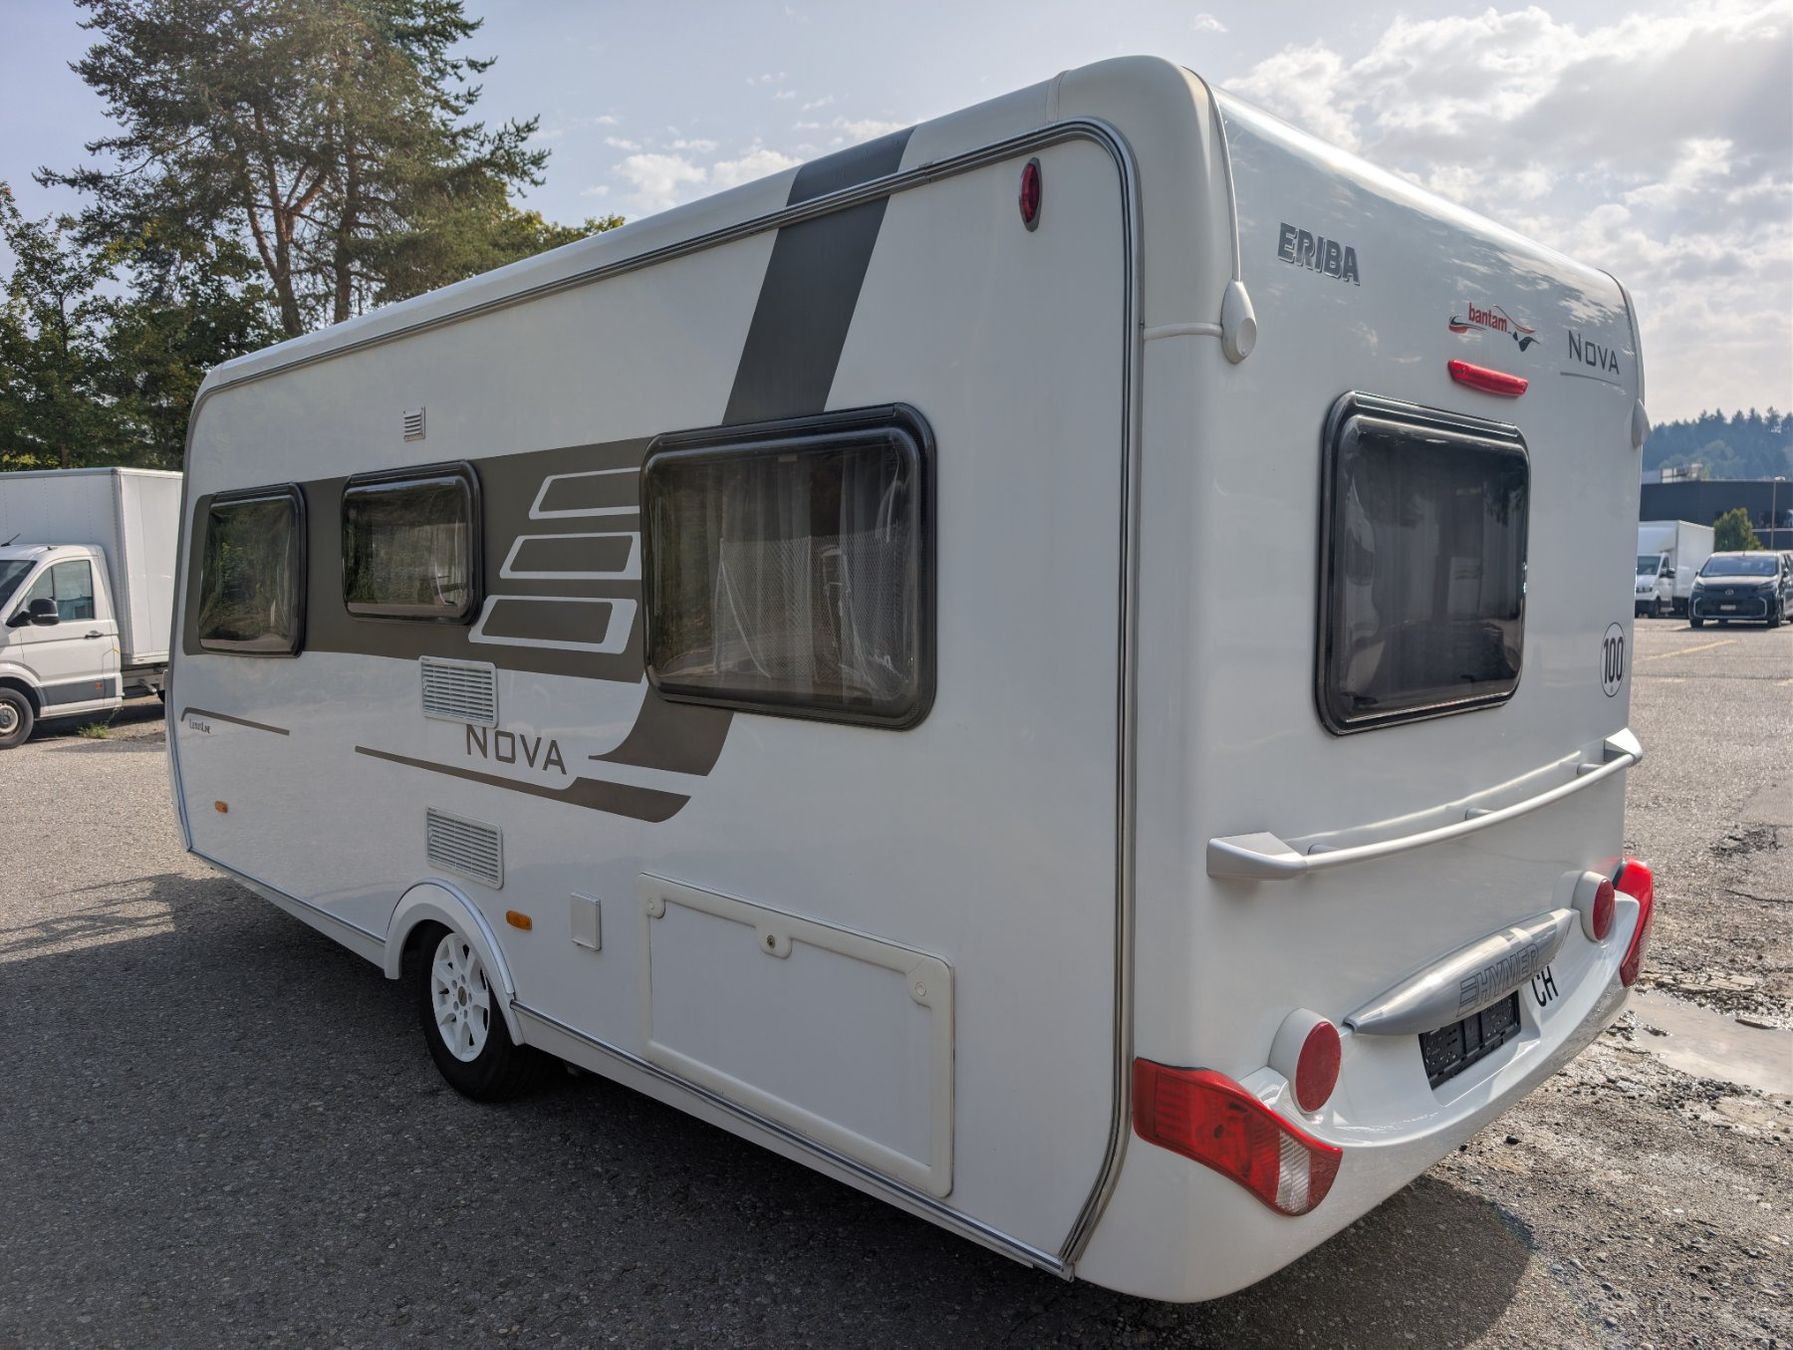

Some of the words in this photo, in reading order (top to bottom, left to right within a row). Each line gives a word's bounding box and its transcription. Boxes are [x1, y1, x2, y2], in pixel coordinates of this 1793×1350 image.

[1278, 222, 1360, 286] ERIBA
[1468, 303, 1508, 332] bantam
[1568, 330, 1620, 374] NOVA
[1604, 636, 1624, 684] 100
[466, 724, 567, 775] NOVA
[1461, 944, 1539, 1010] HYMER
[1531, 965, 1559, 1007] CH
